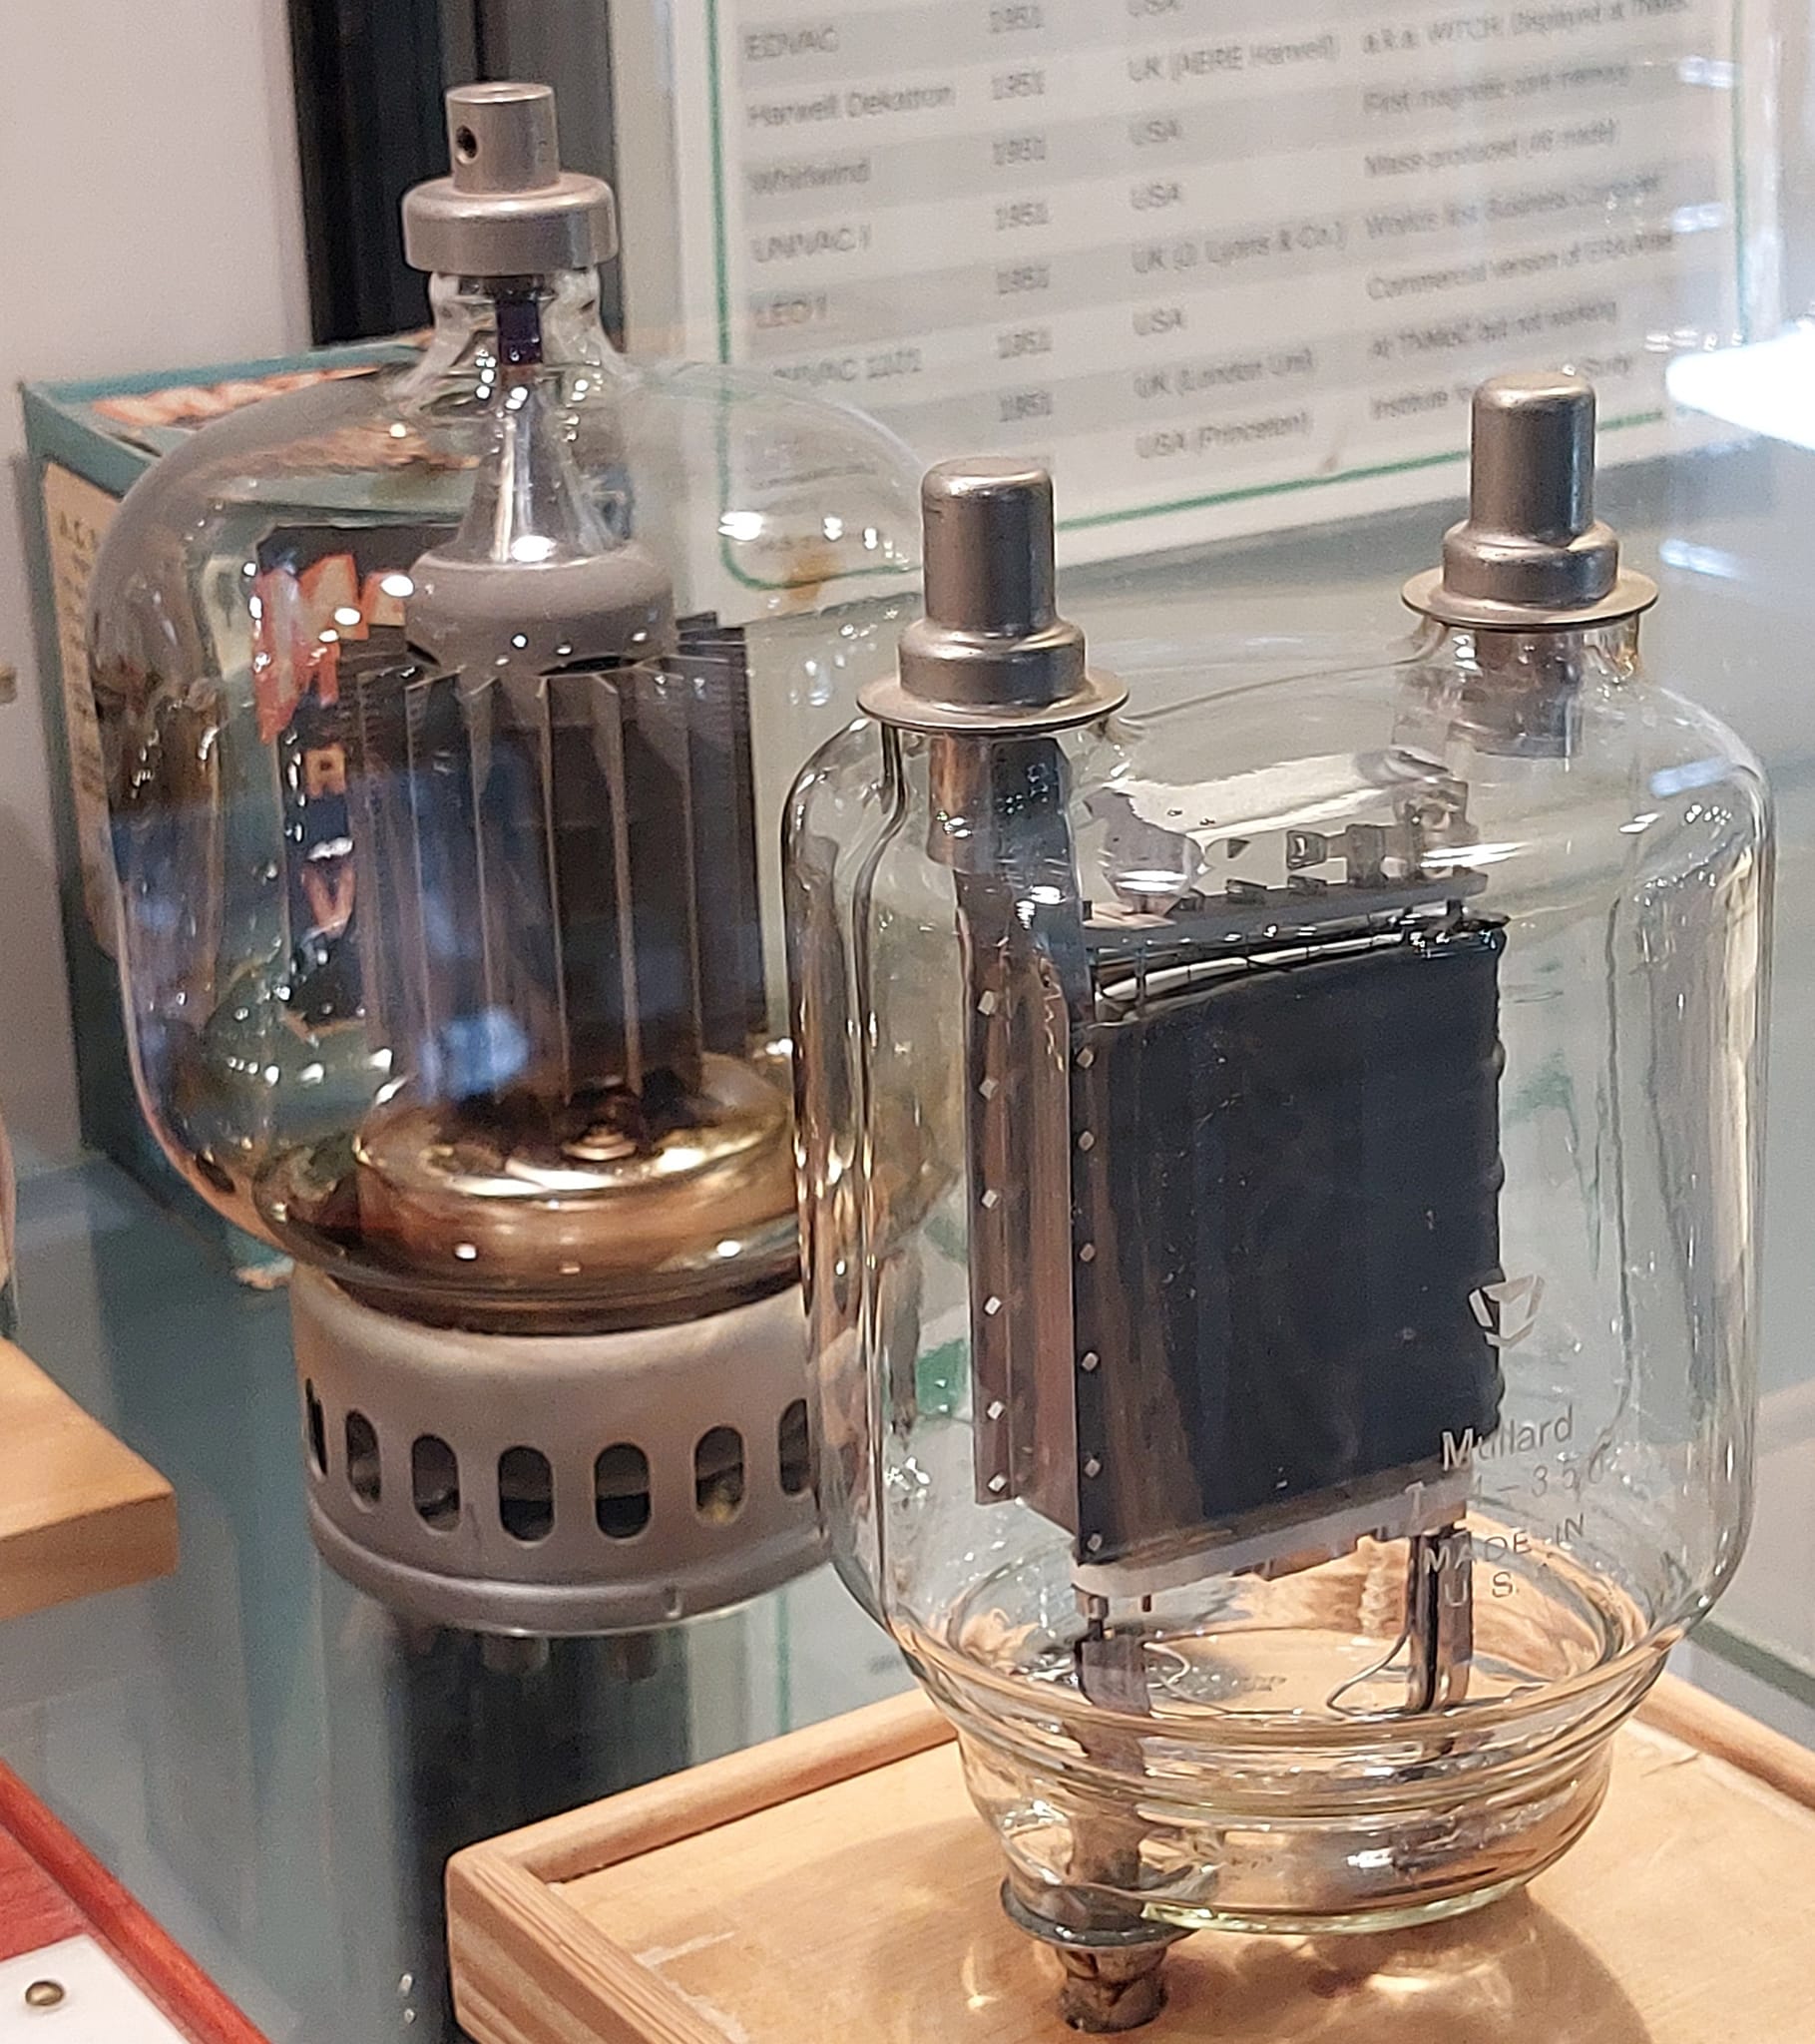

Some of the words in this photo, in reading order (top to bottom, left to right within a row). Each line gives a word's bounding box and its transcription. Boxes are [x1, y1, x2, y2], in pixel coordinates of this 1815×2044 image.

[744, 24, 839, 61] EDVAC
[1128, 54, 1162, 83] UK
[1248, 34, 1340, 68] Harwell)
[991, 69, 1046, 101] 1951
[746, 94, 840, 129] Harwell
[845, 85, 956, 119] Dekatron
[1129, 118, 1182, 147] USA
[993, 136, 1047, 166] 1951
[747, 158, 871, 195] Whirlwind
[1130, 182, 1184, 211] USA
[995, 201, 1050, 231] 1951
[750, 227, 856, 263] UNIVAC
[1131, 244, 1166, 274] UK
[1204, 232, 1269, 267] Lyons
[996, 262, 1051, 295] 1951
[1366, 262, 1487, 301] Commercial
[1492, 253, 1559, 279] version
[751, 294, 812, 329] LEO
[1132, 307, 1186, 336] USA
[997, 325, 1052, 359] 1951
[1134, 367, 1169, 399] UK
[1135, 430, 1185, 459] USA
[1193, 410, 1312, 455] (Princeton)
[1443, 1402, 1573, 1471] Mullard
[1424, 1530, 1533, 1575] MADE
[1556, 1513, 1585, 1549] IN
